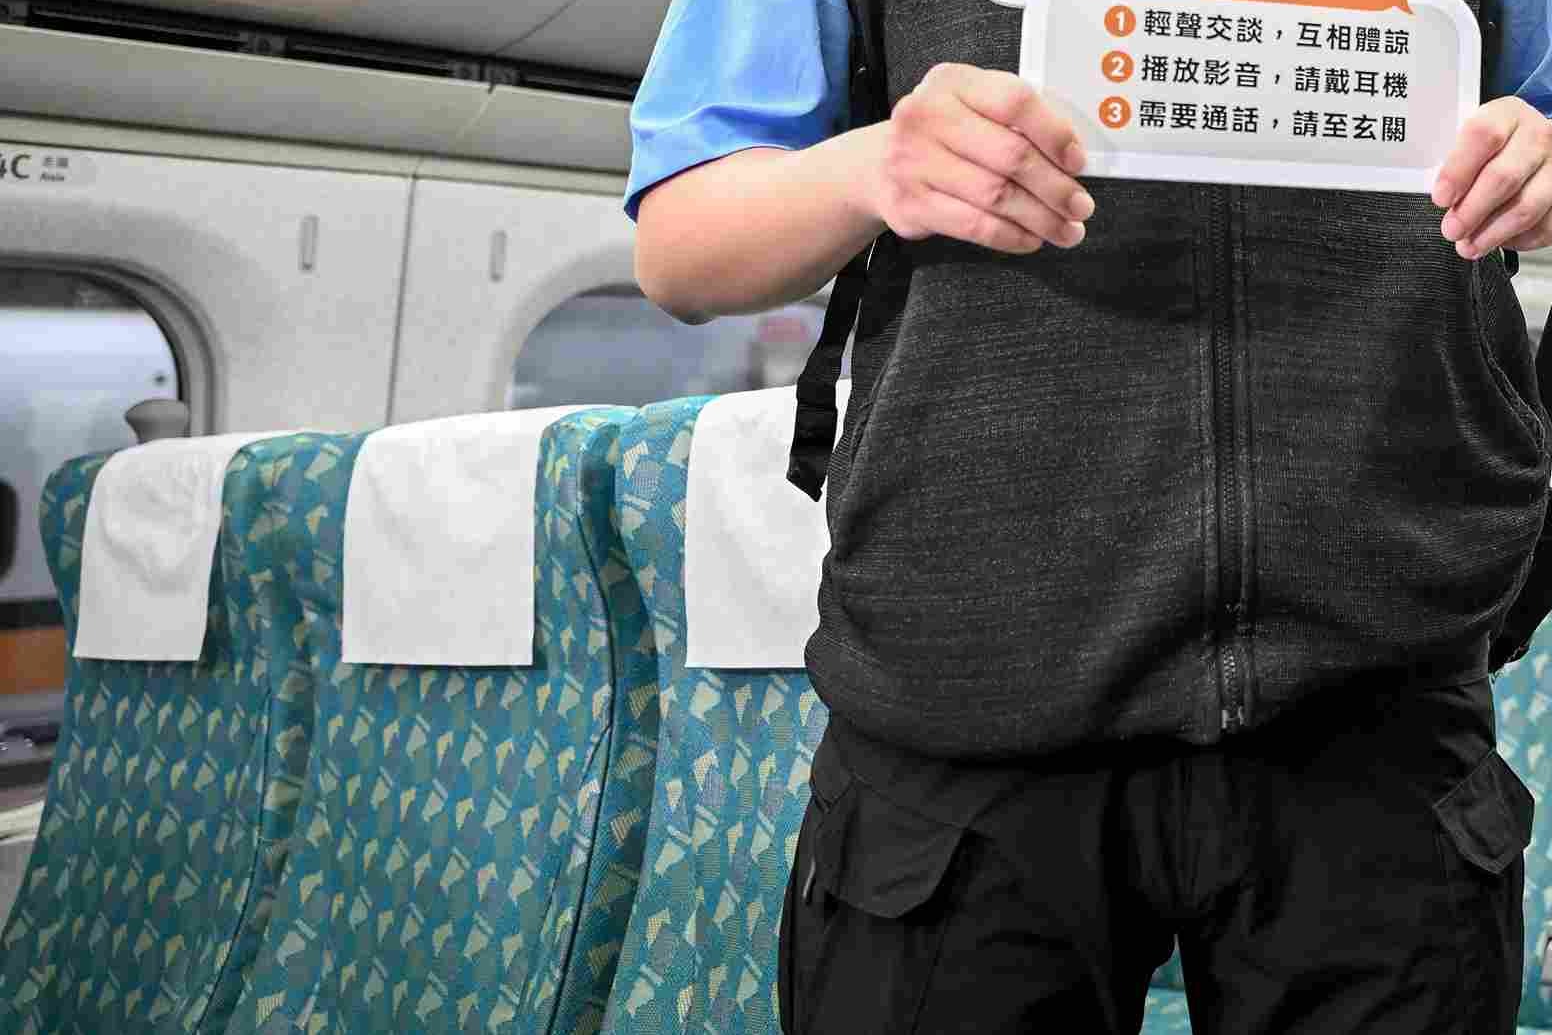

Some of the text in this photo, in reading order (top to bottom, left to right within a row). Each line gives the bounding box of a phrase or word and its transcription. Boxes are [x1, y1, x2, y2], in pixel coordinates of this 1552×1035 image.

[1143, 8, 1410, 55] 輕聲交談，互相體諒
[1140, 53, 1409, 100] 播放影音，請戴耳機
[1138, 99, 1407, 143] 需要通話，請至玄關
